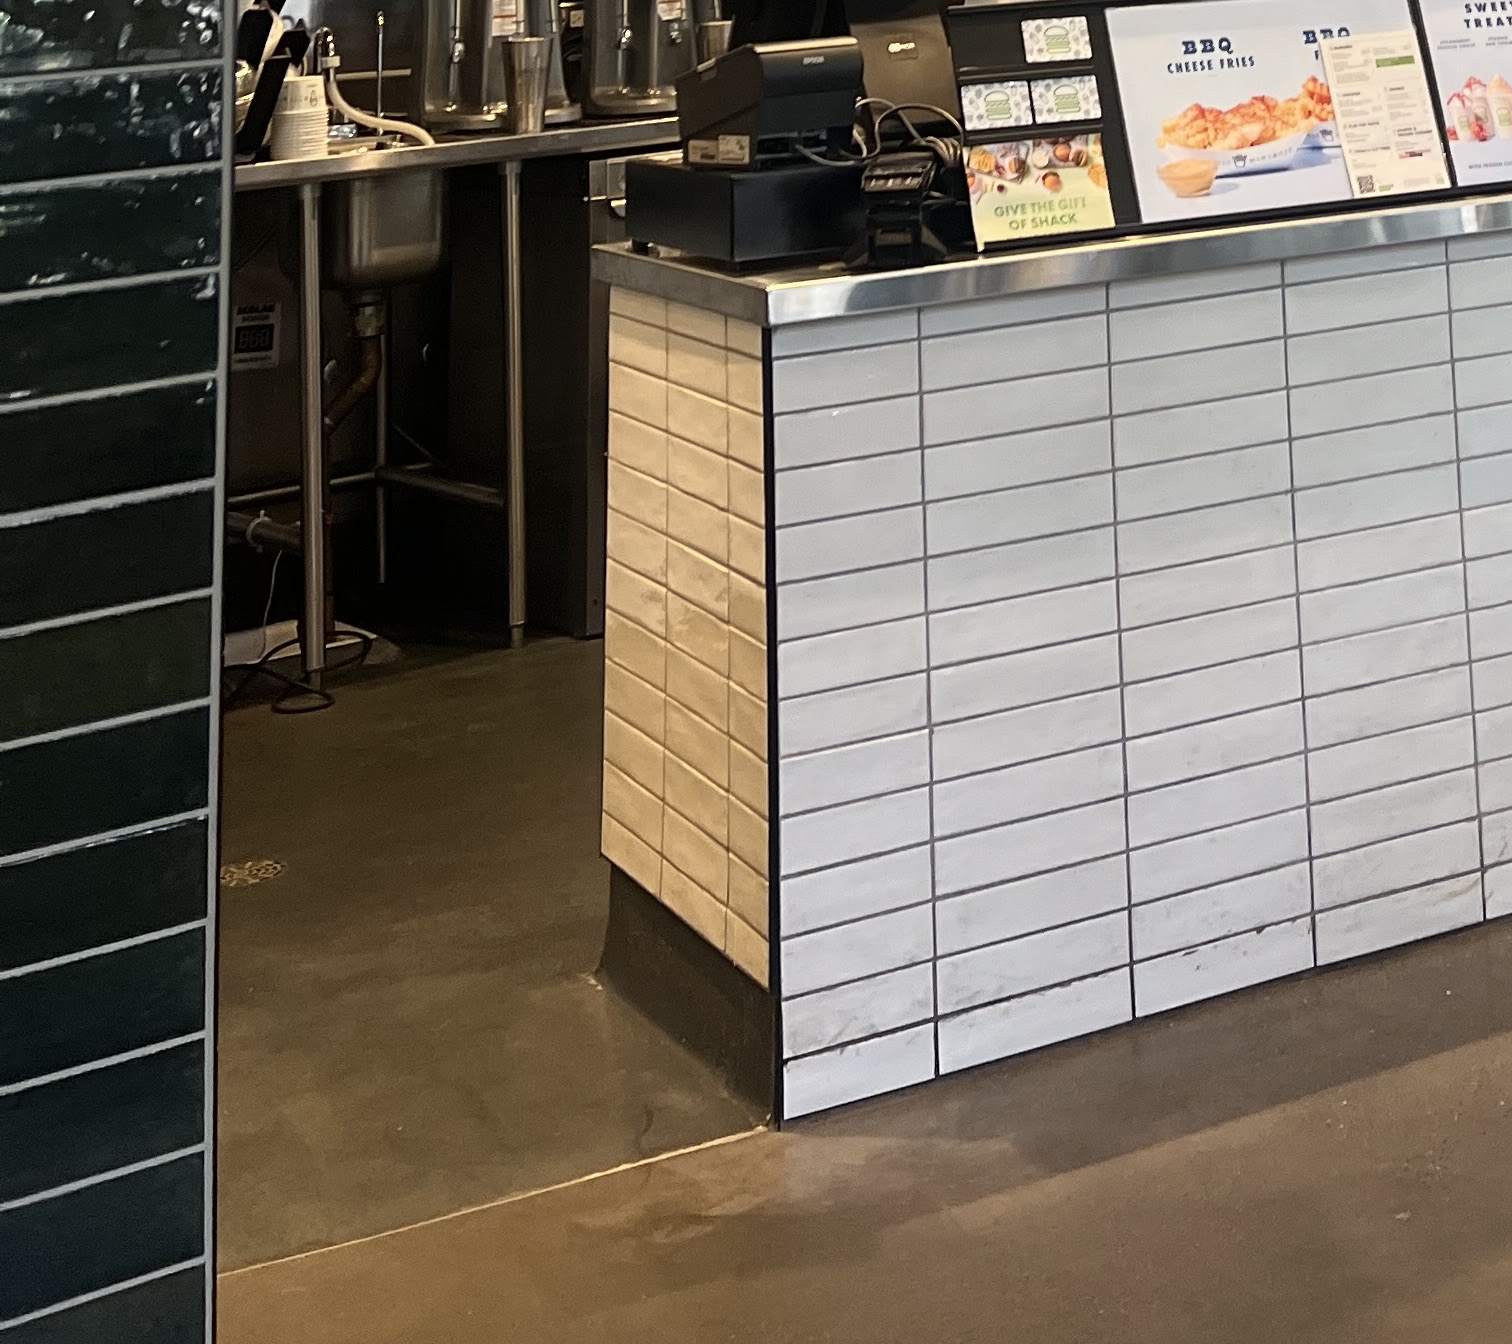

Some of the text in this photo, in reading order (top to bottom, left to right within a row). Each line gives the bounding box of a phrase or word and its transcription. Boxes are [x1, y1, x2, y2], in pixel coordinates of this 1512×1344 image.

[1181, 37, 1234, 55] BBQ
[1167, 55, 1255, 74] CHEESE FRIES
[994, 197, 1086, 217] GIVE THE GIFT
[1008, 213, 1078, 230] OF SHACK
